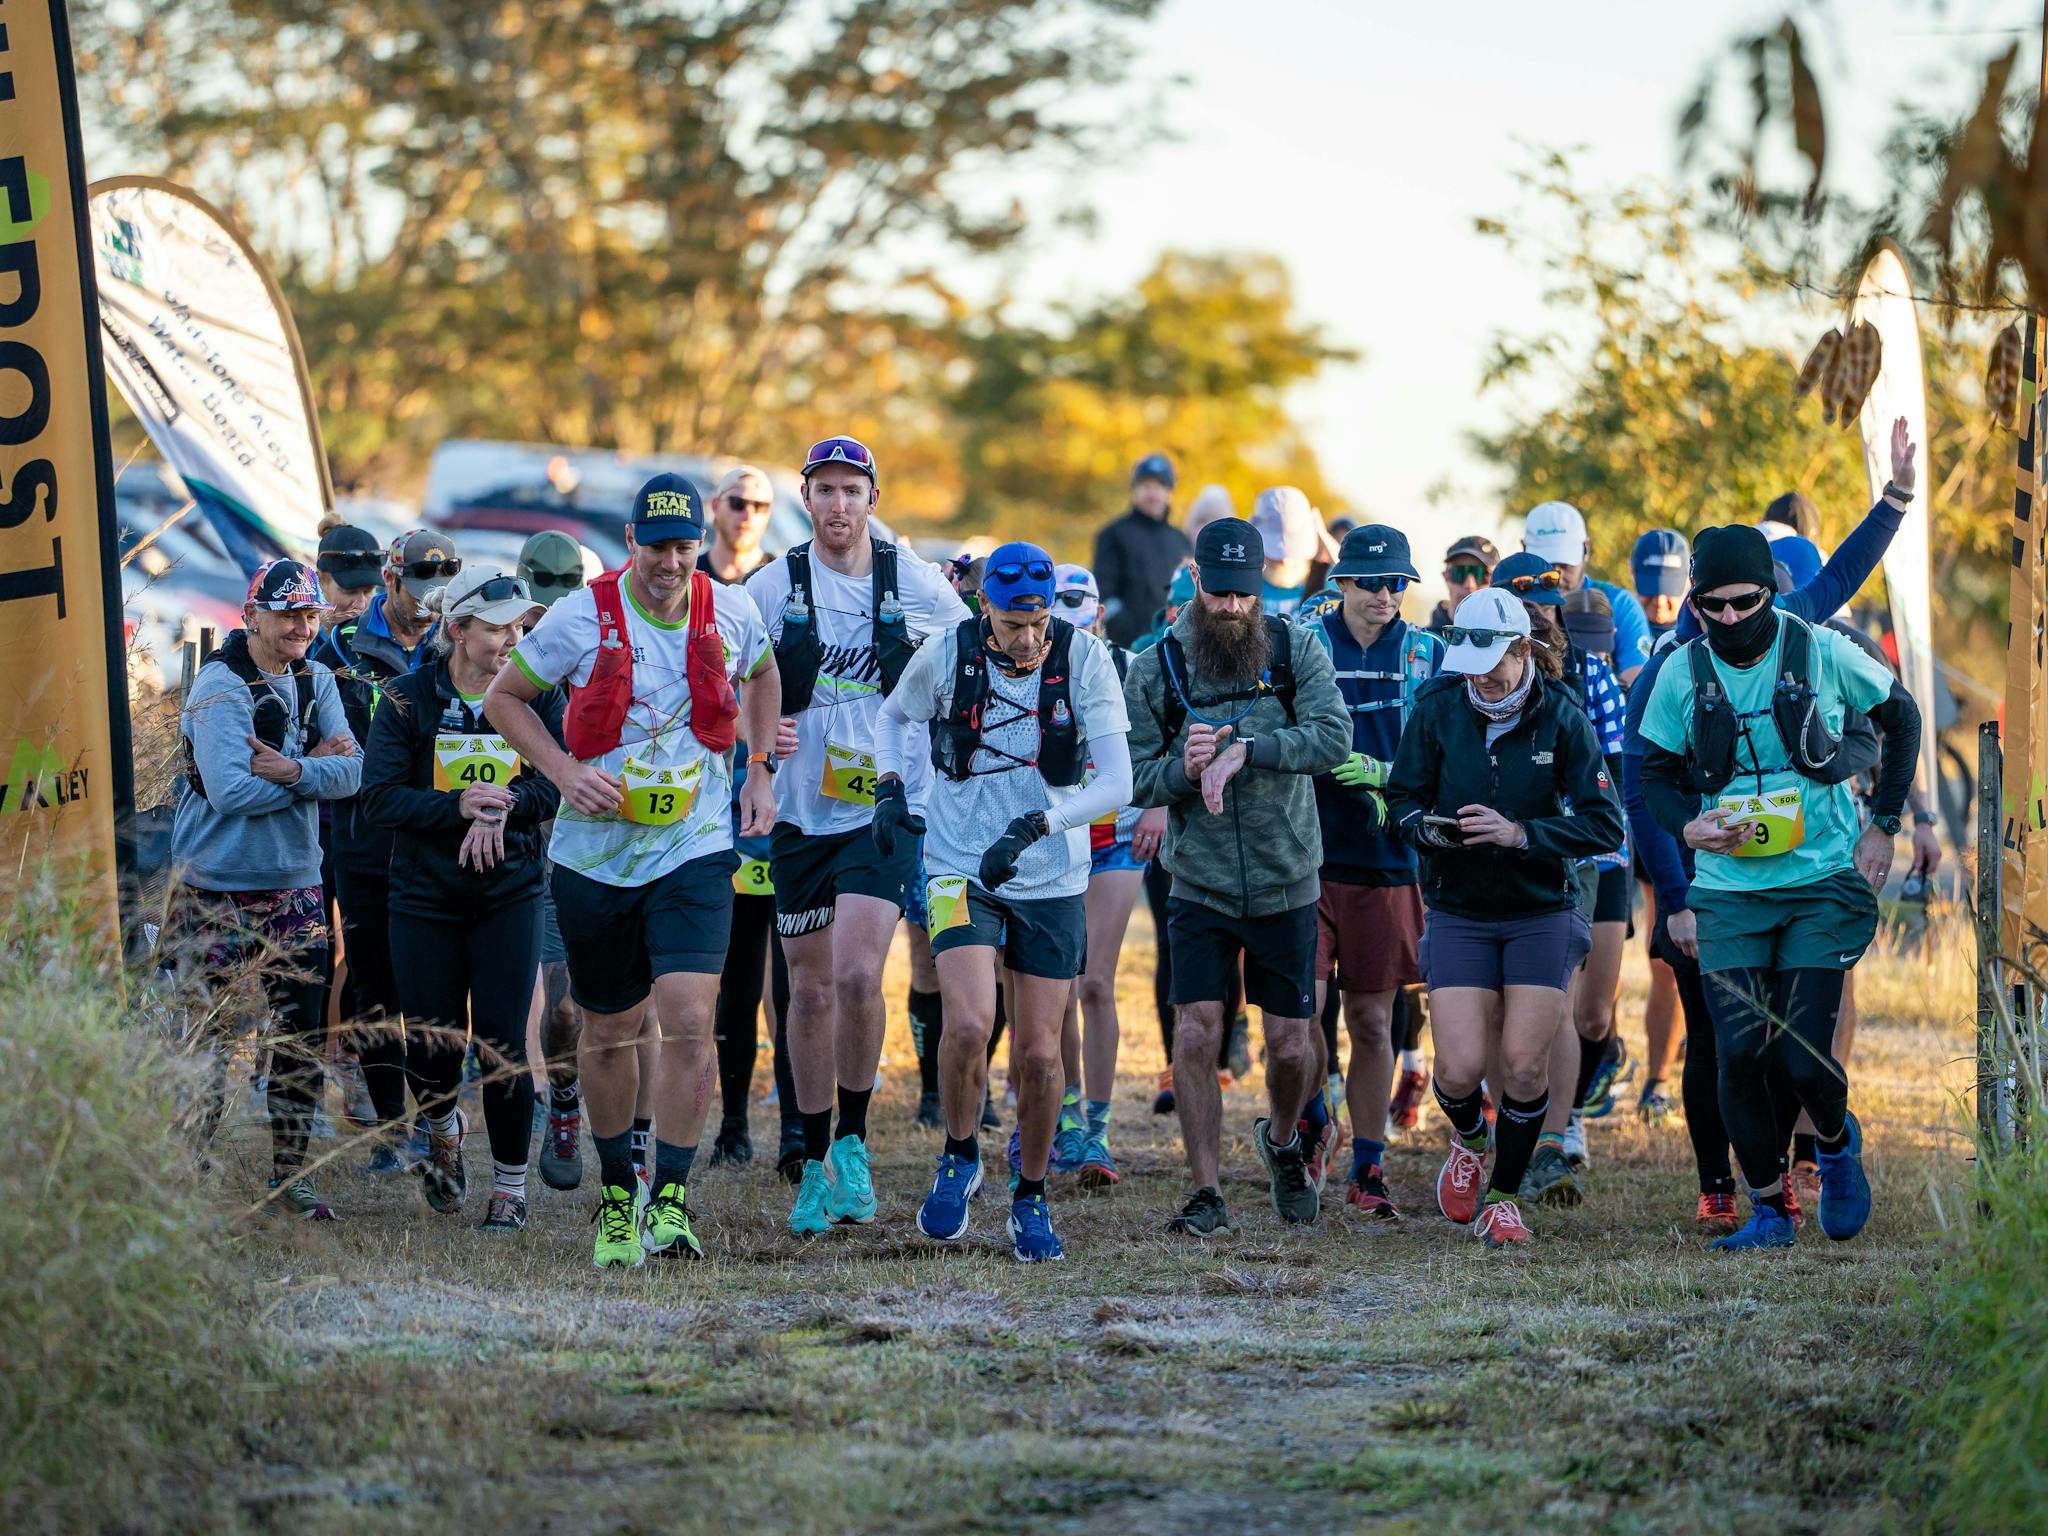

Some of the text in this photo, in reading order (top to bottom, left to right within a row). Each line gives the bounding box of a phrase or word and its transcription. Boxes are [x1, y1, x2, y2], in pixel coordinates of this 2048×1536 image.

[647, 508, 691, 518] RUNNERS
[648, 497, 691, 512] TRAIL
[1369, 545, 1384, 553] nrg
[460, 763, 496, 785] 40
[847, 775, 878, 796] 43
[648, 792, 675, 814] 13
[1780, 795, 1797, 804] 50K
[1755, 822, 1770, 845] 9
